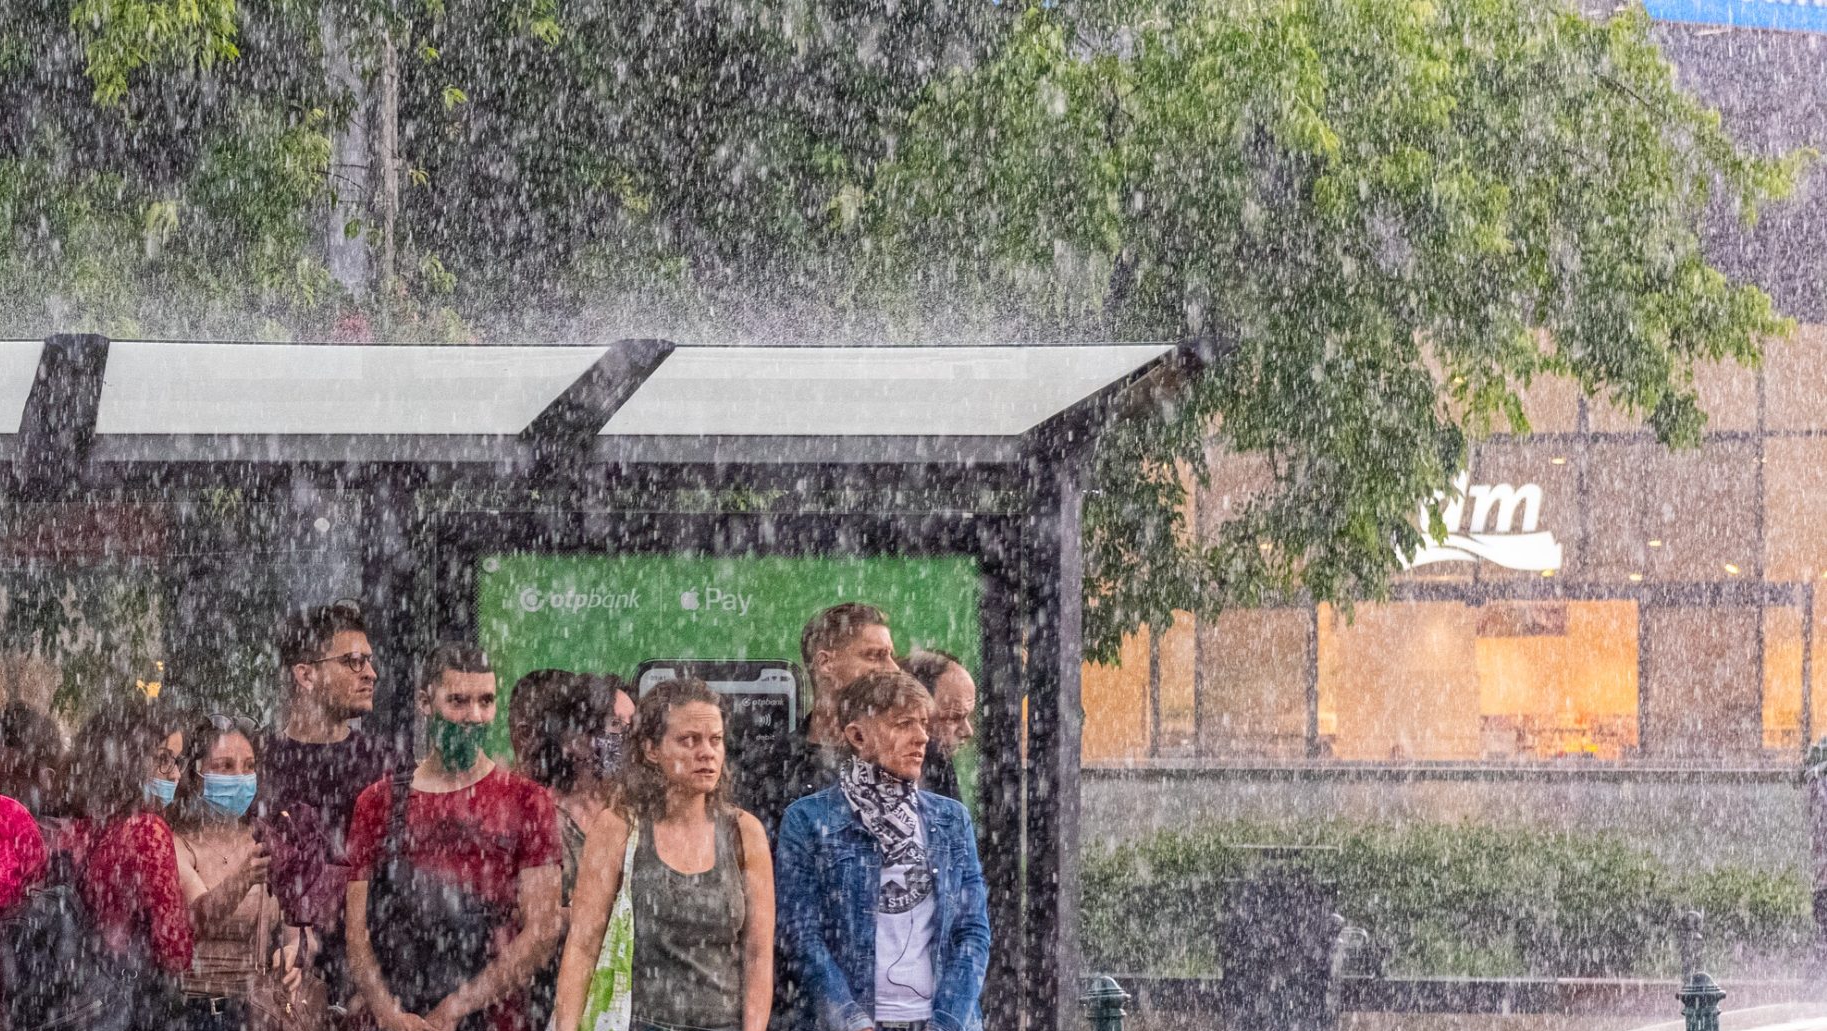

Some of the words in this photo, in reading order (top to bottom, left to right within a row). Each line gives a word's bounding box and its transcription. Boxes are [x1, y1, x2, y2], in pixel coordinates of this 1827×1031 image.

[1420, 469, 1543, 532] dm
[550, 587, 641, 613] otpbank
[705, 586, 753, 616] Pay
